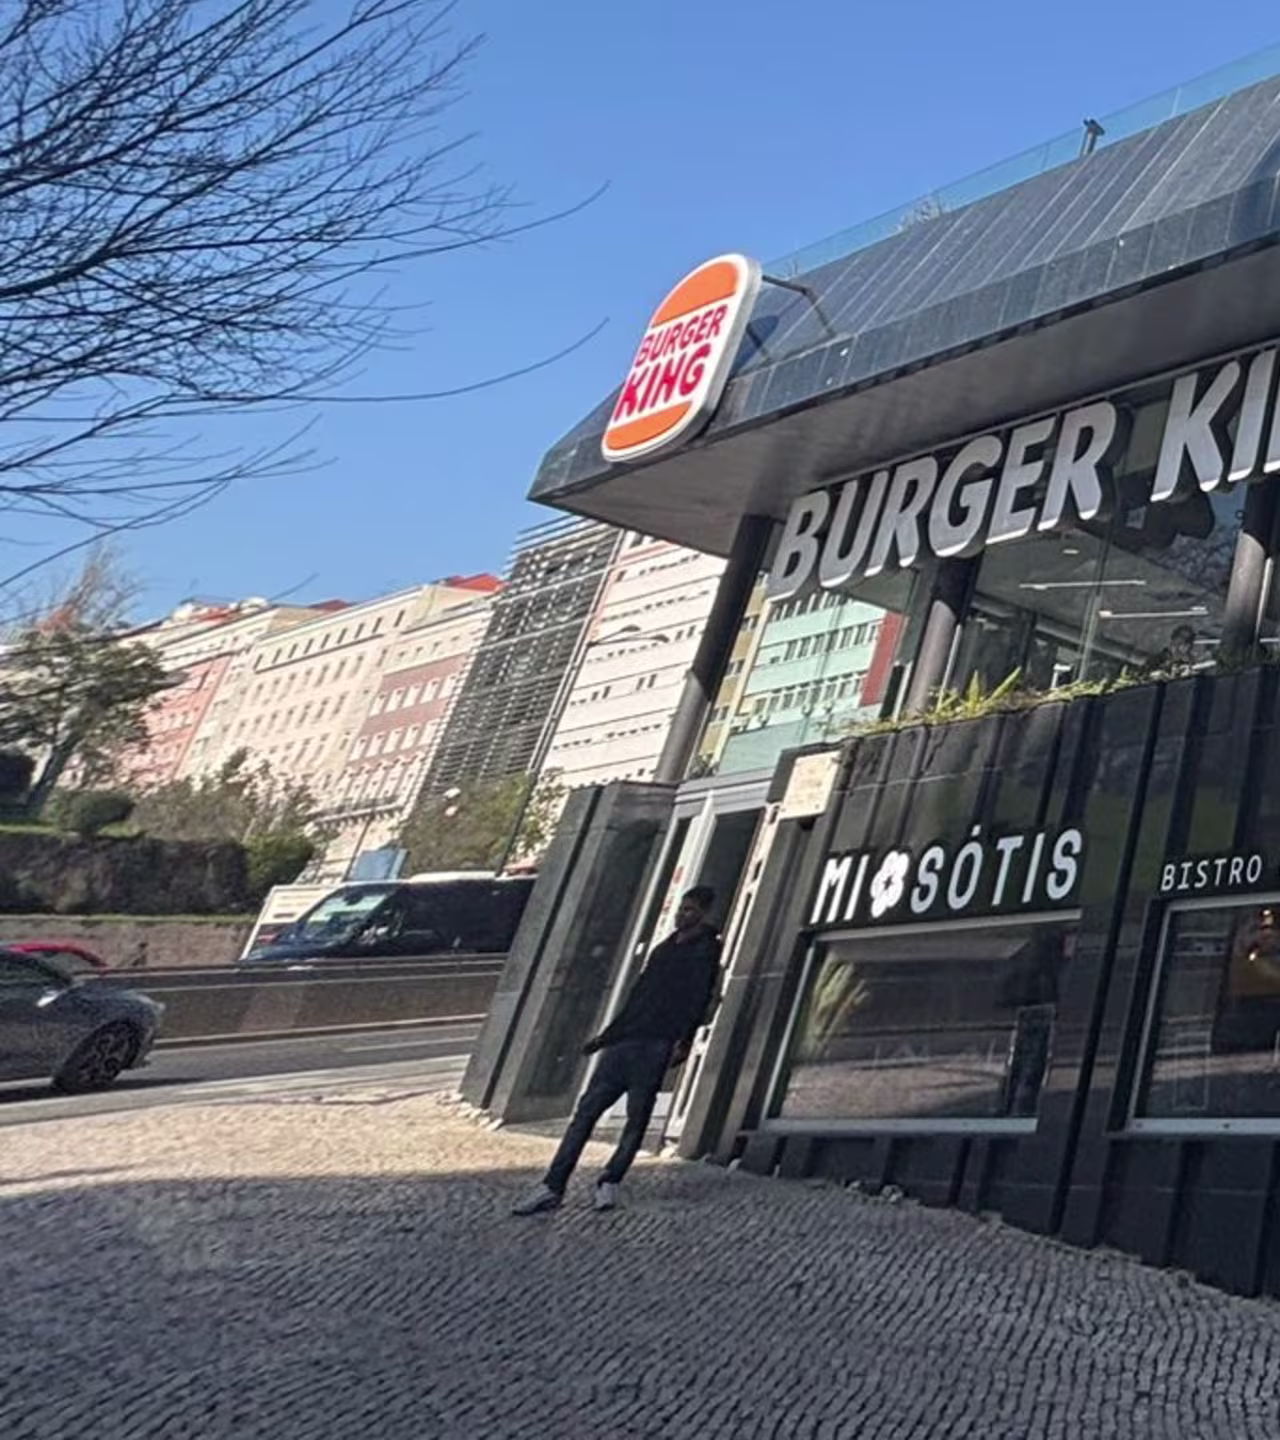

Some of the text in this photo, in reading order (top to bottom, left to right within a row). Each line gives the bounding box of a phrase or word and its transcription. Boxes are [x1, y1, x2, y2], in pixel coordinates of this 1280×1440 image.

[635, 304, 728, 368] BURGER
[613, 343, 711, 422] KING
[762, 400, 1117, 603] BURGER
[1160, 854, 1262, 892] BISTRO
